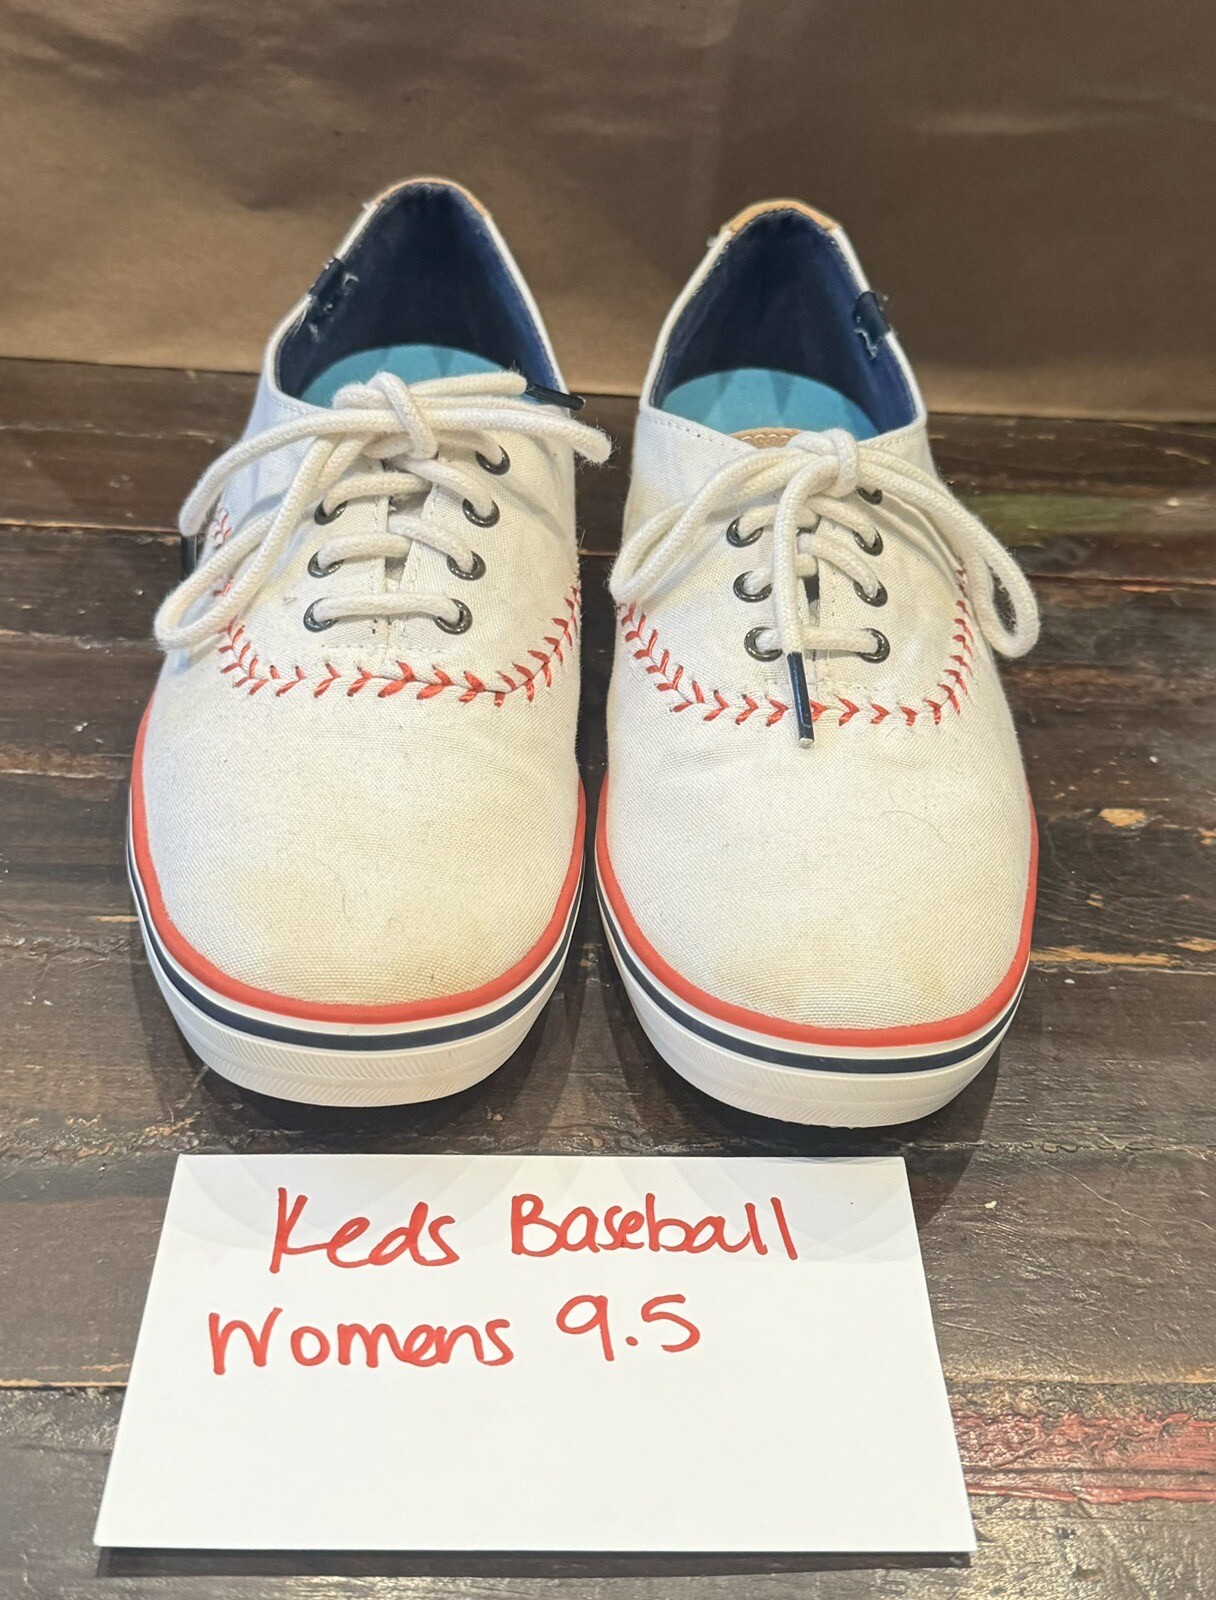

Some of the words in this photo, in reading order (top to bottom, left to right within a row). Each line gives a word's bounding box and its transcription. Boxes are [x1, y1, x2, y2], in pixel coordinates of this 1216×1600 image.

[269, 1187, 459, 1275] Keds
[510, 1192, 800, 1260] Baseball
[207, 1307, 515, 1376] Womens
[556, 1294, 701, 1362] 9.5
